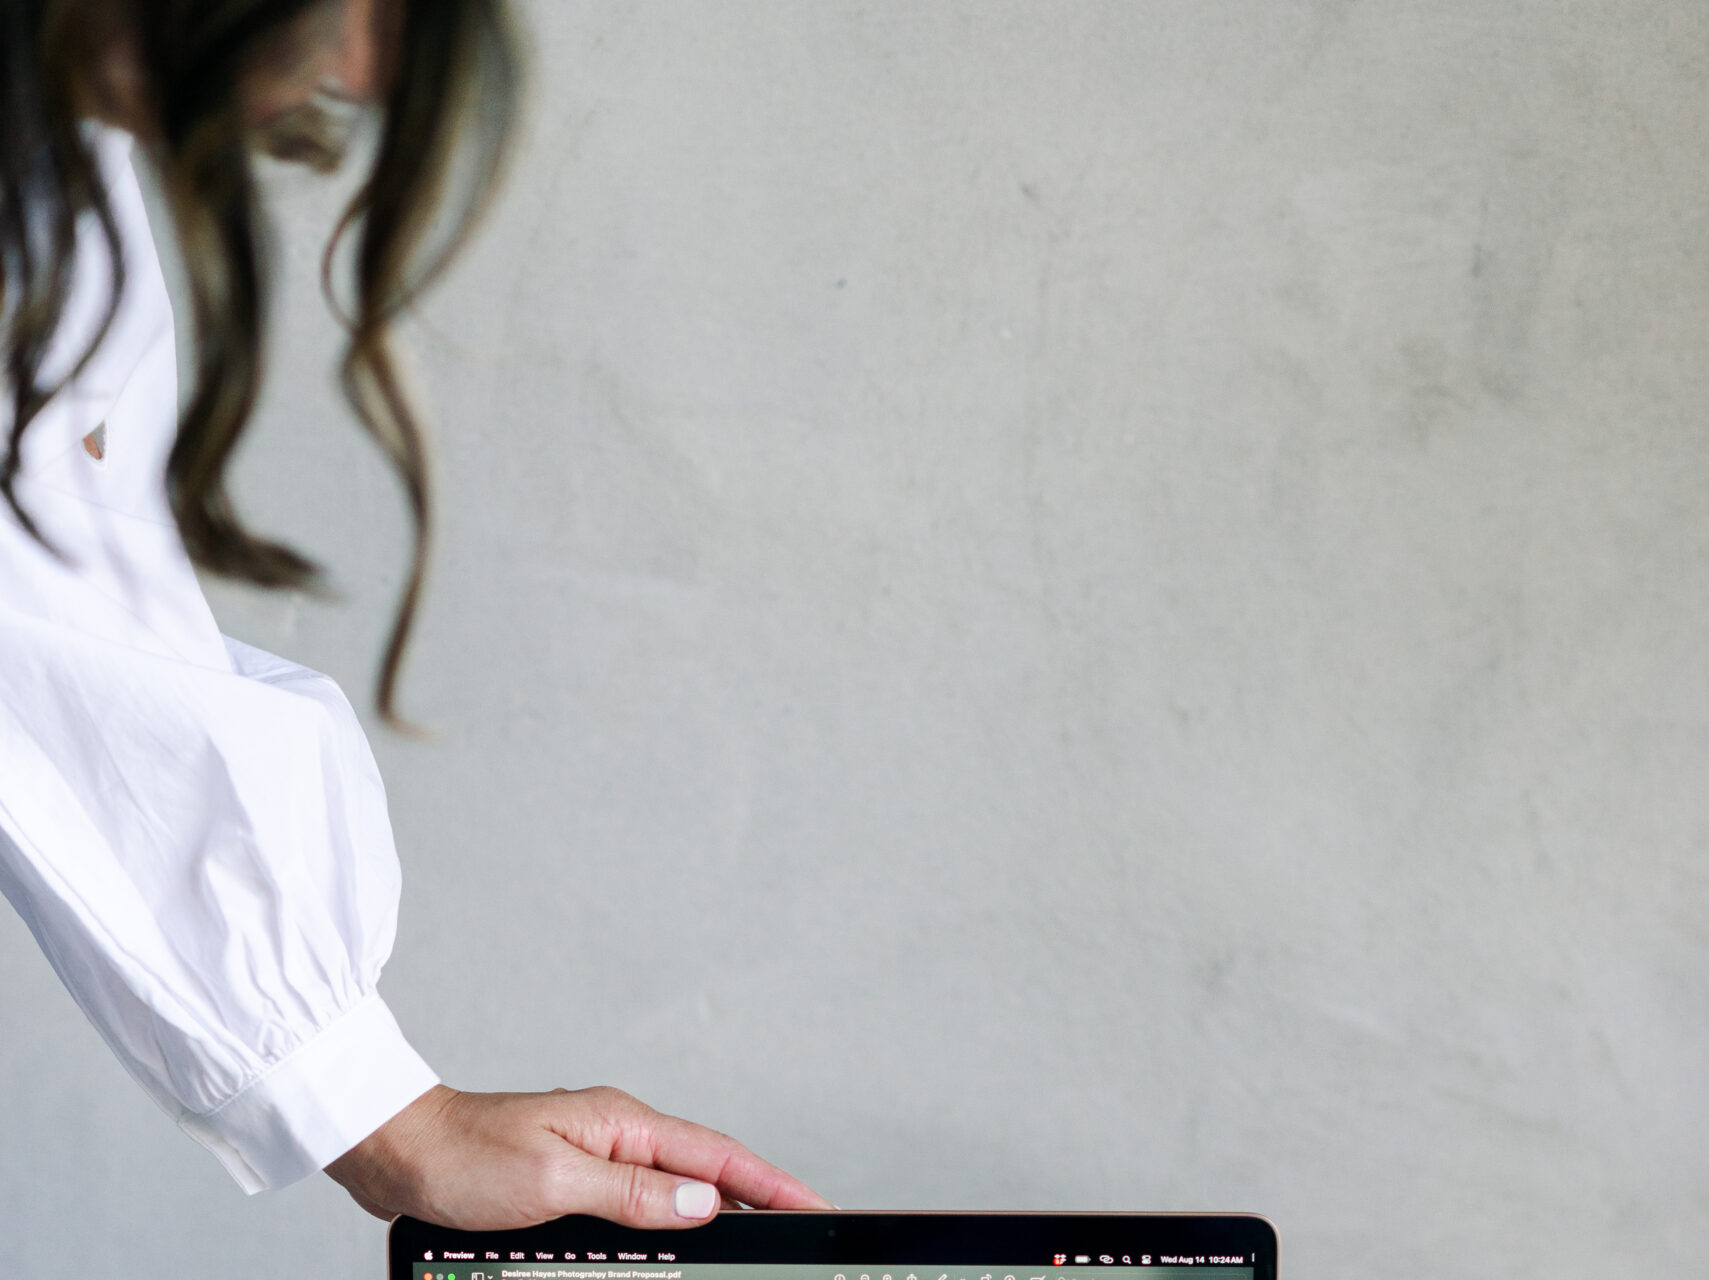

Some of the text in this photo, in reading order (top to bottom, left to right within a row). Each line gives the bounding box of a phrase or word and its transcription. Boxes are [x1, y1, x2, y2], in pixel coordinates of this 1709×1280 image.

[564, 1252, 576, 1260] Go
[587, 1252, 607, 1260] Tools
[658, 1253, 676, 1261] Help
[1160, 1256, 1178, 1264] Wed
[1179, 1256, 1194, 1265] Aug
[1195, 1256, 1205, 1264] 14
[501, 1270, 531, 1278] Desiree
[532, 1270, 556, 1280] Hayes
[632, 1271, 682, 1280] Proposal.pdf
